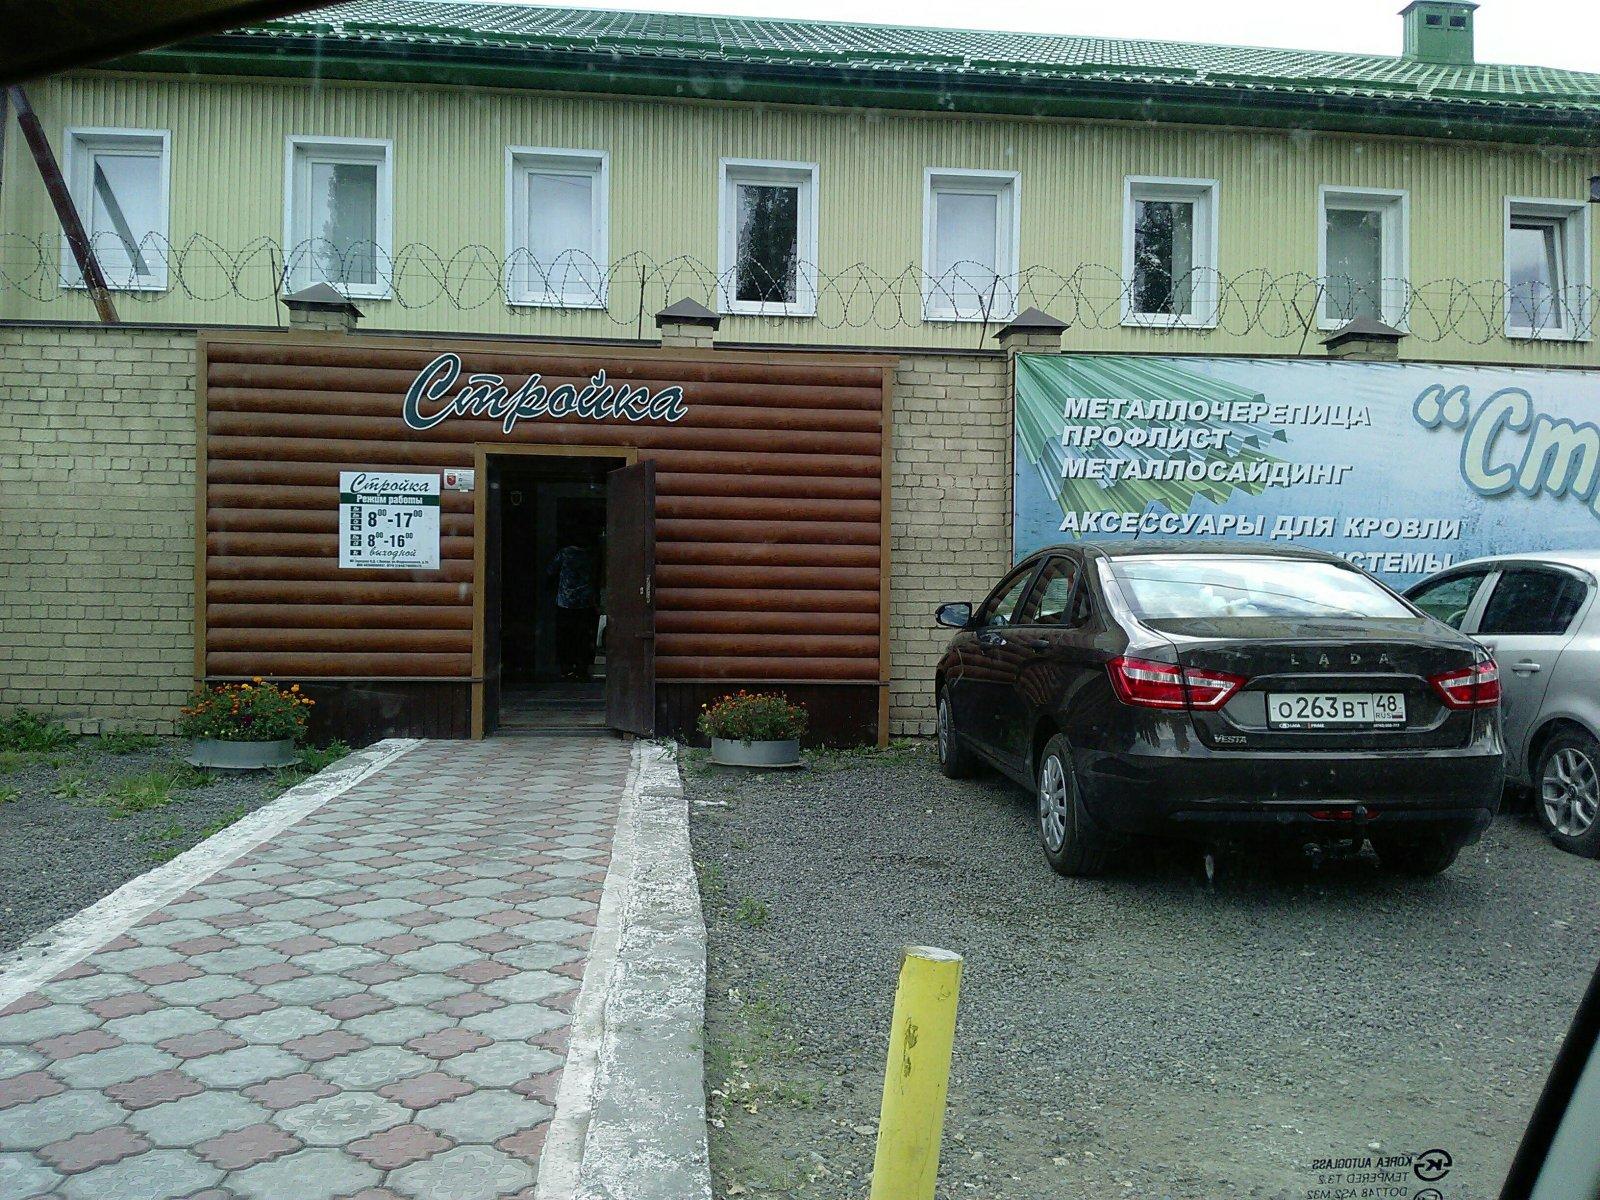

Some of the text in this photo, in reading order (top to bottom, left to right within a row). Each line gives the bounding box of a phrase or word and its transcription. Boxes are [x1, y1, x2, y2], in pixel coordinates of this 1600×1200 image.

[402, 352, 688, 434] Стройка
[1063, 397, 1371, 429] МЕТАЛЛОЧЕРЕПИЦА
[1061, 425, 1231, 450] ПРОФЛИСТ
[1061, 457, 1353, 487] МЕТАЛЛОСАЙДИНГ
[350, 473, 430, 495] Стройка
[356, 494, 423, 506] Режим работы
[1059, 511, 1462, 541] АКСЕССУАРЫ ДЛЯ КРОВЛИ
[1290, 653, 1389, 666] LADA
[1375, 712, 1392, 720] RUS
[1213, 734, 1248, 745] VESTA
